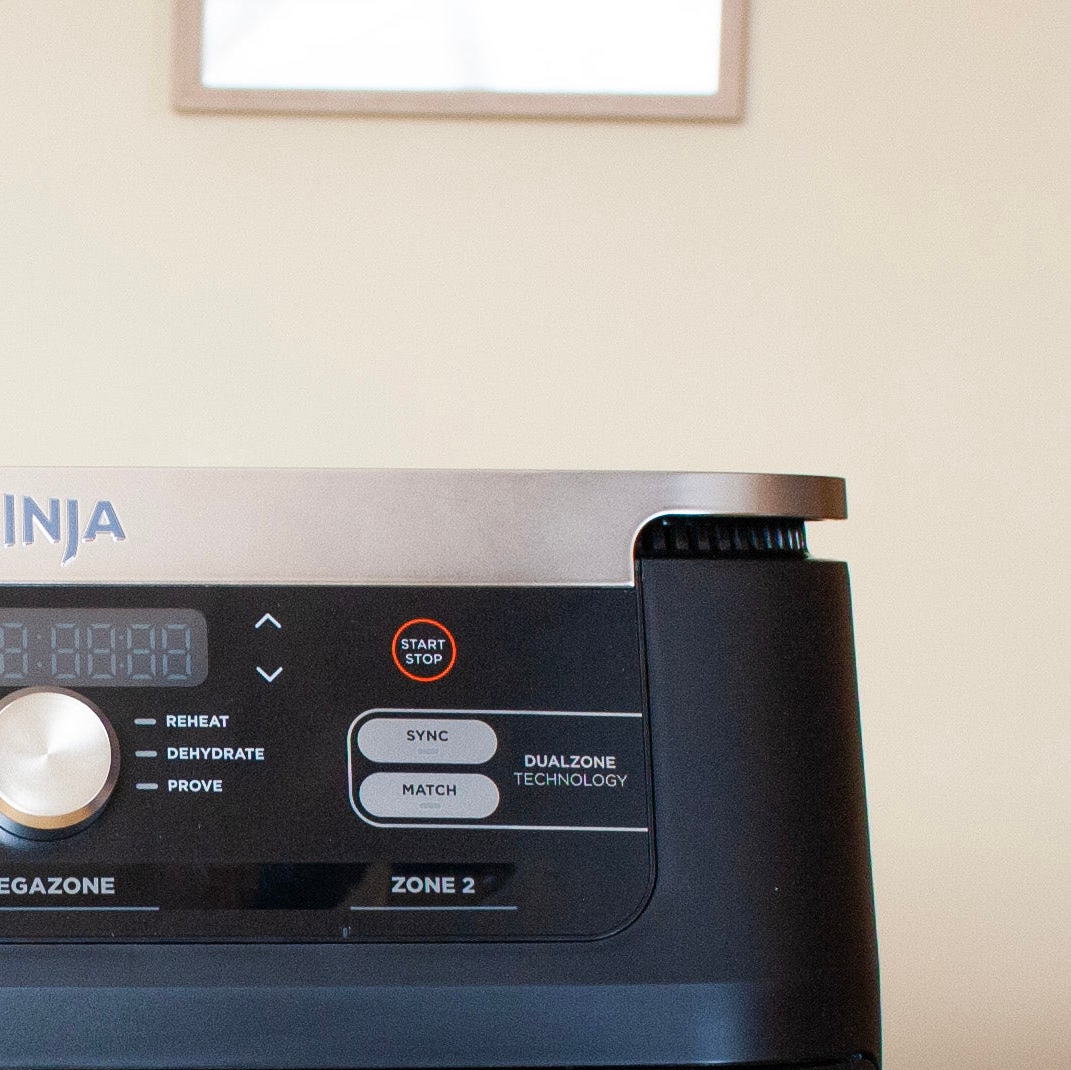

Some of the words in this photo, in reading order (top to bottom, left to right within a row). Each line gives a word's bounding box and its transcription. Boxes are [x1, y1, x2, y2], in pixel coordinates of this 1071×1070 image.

[400, 637, 446, 650] START
[405, 652, 443, 665] STOP
[165, 714, 230, 728] REHEAT
[406, 729, 449, 742] SYNC
[167, 746, 265, 761] DEHYDRATE
[524, 754, 617, 770] DUALZONE
[167, 779, 223, 793] PROVE
[514, 772, 628, 788] TECHNOLOGY
[402, 783, 457, 797] MATCH
[391, 876, 456, 894] ZONE
[462, 876, 476, 894] 2
